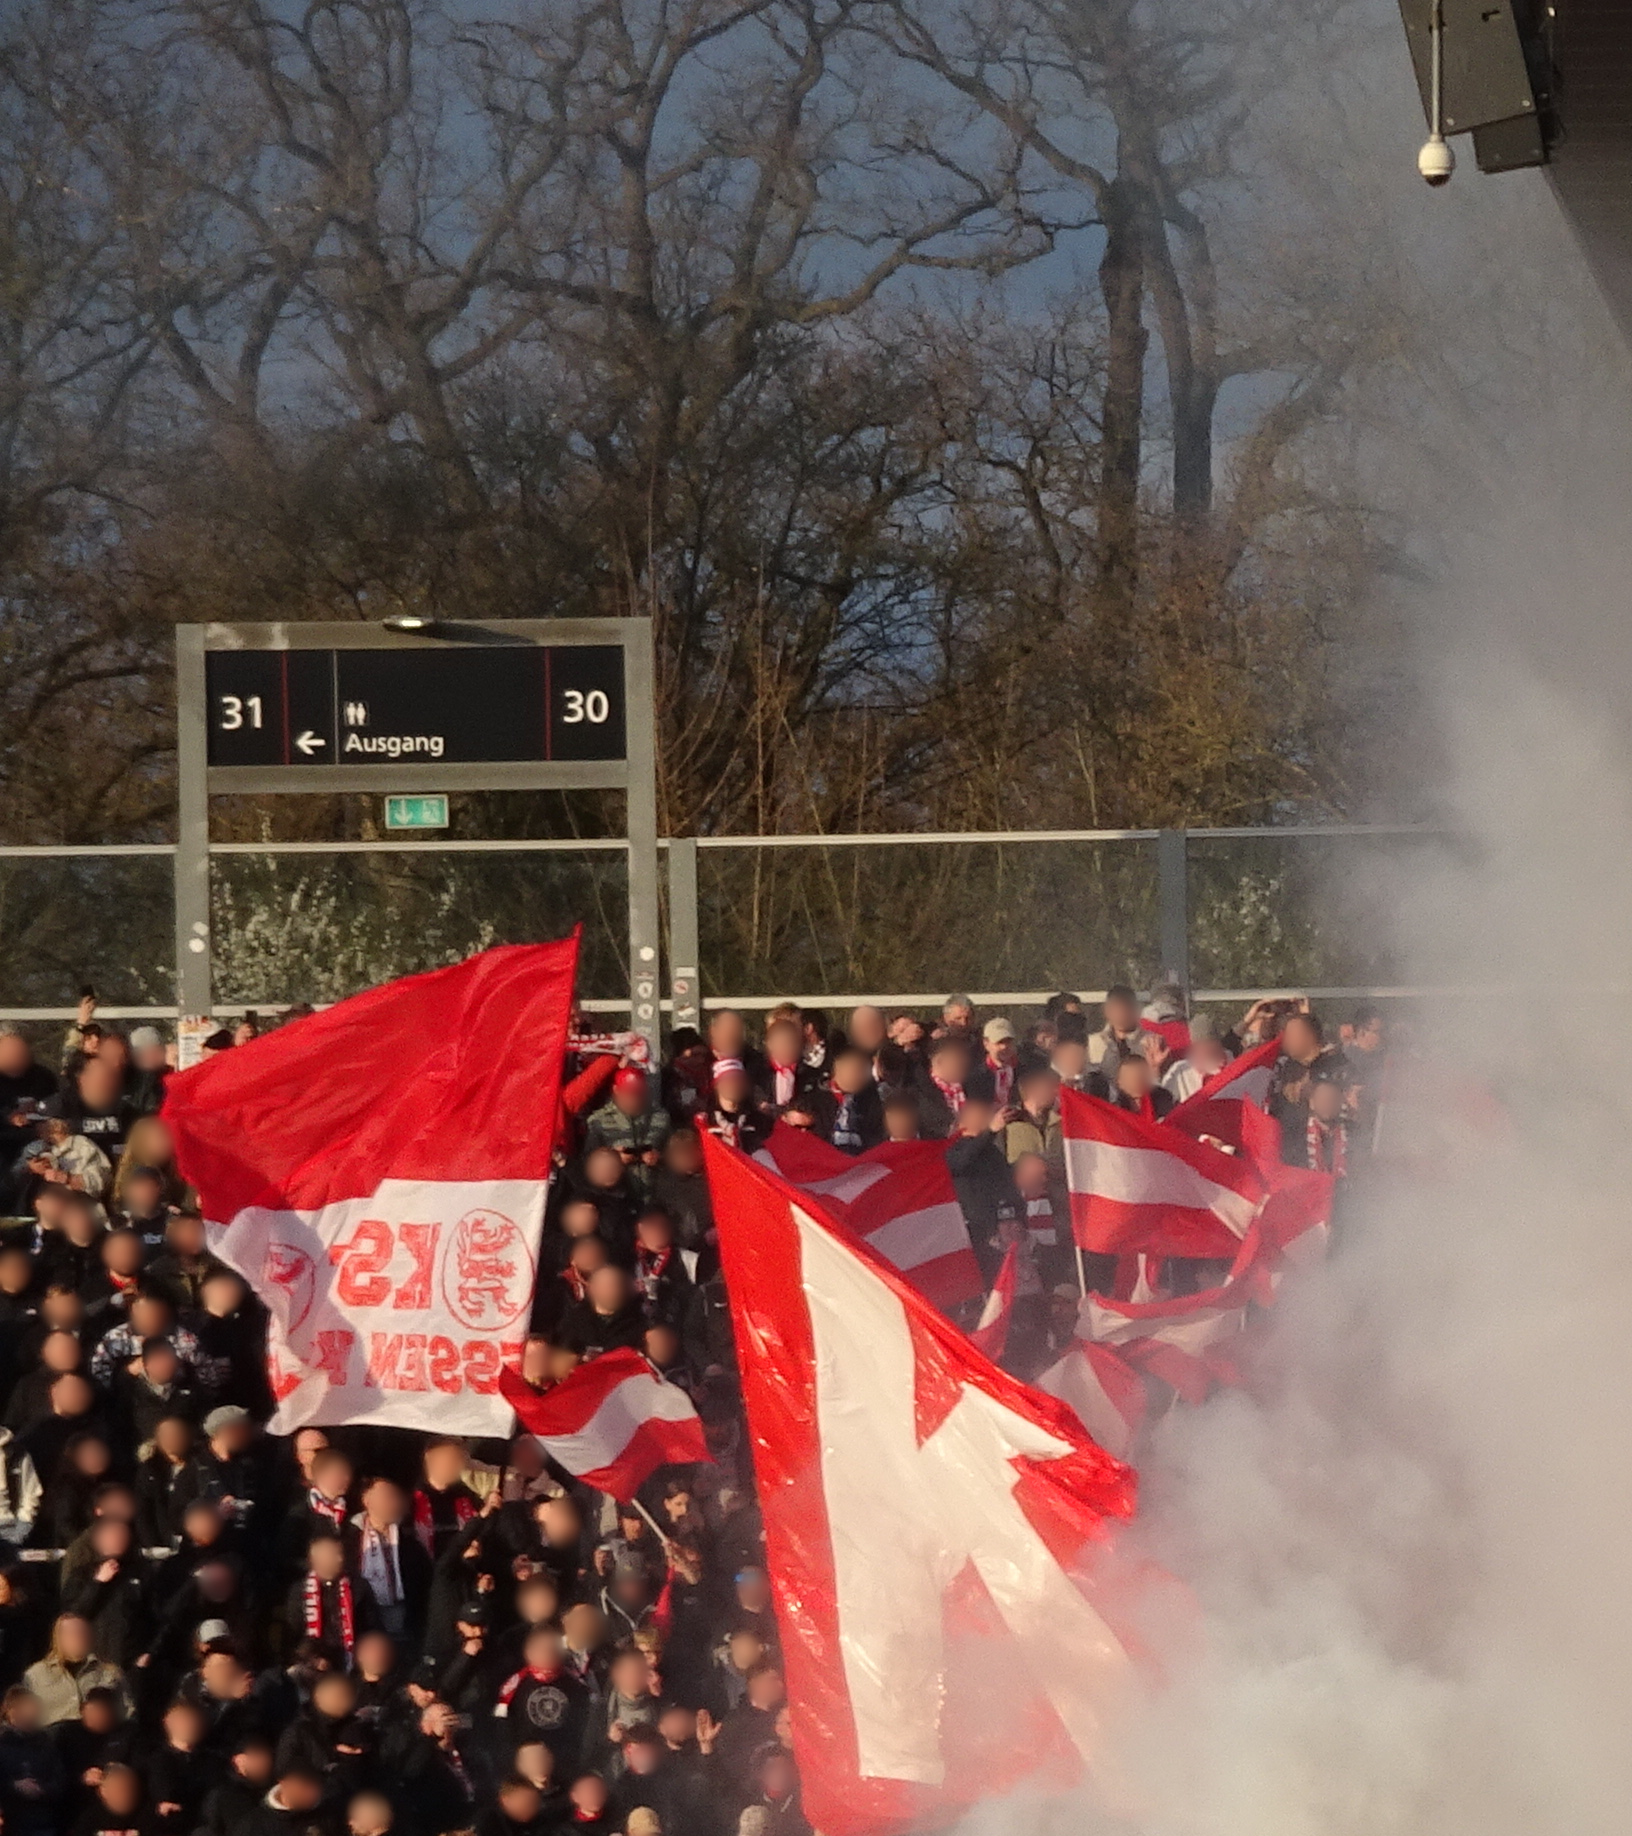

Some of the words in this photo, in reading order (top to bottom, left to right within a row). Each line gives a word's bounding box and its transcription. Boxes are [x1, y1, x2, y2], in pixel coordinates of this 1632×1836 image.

[220, 695, 264, 731] 31
[562, 690, 609, 724] 30
[344, 732, 445, 758] Ausgang
